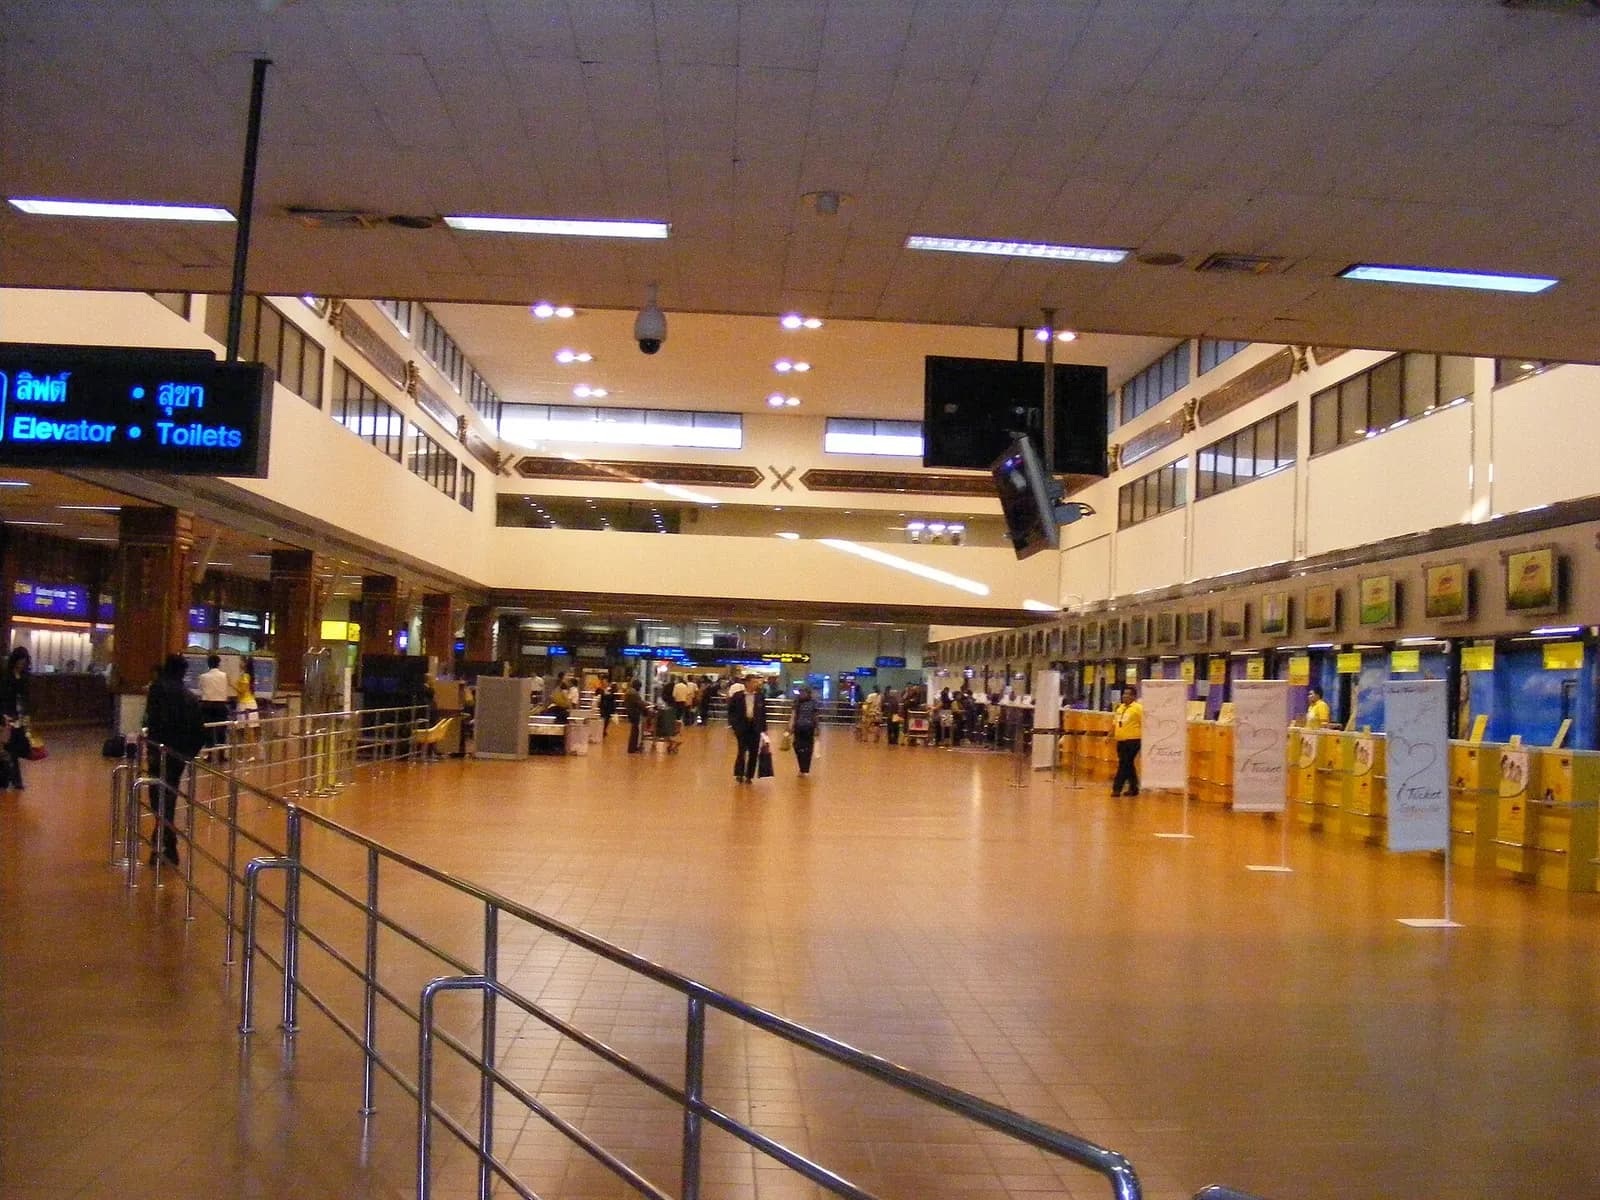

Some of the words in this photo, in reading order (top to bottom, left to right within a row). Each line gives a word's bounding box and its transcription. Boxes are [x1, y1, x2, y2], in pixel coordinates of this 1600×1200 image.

[16, 371, 72, 402] ลิฟต์
[158, 383, 204, 416] สุขา
[12, 416, 117, 444] Elevator
[157, 422, 242, 448] Toilets
